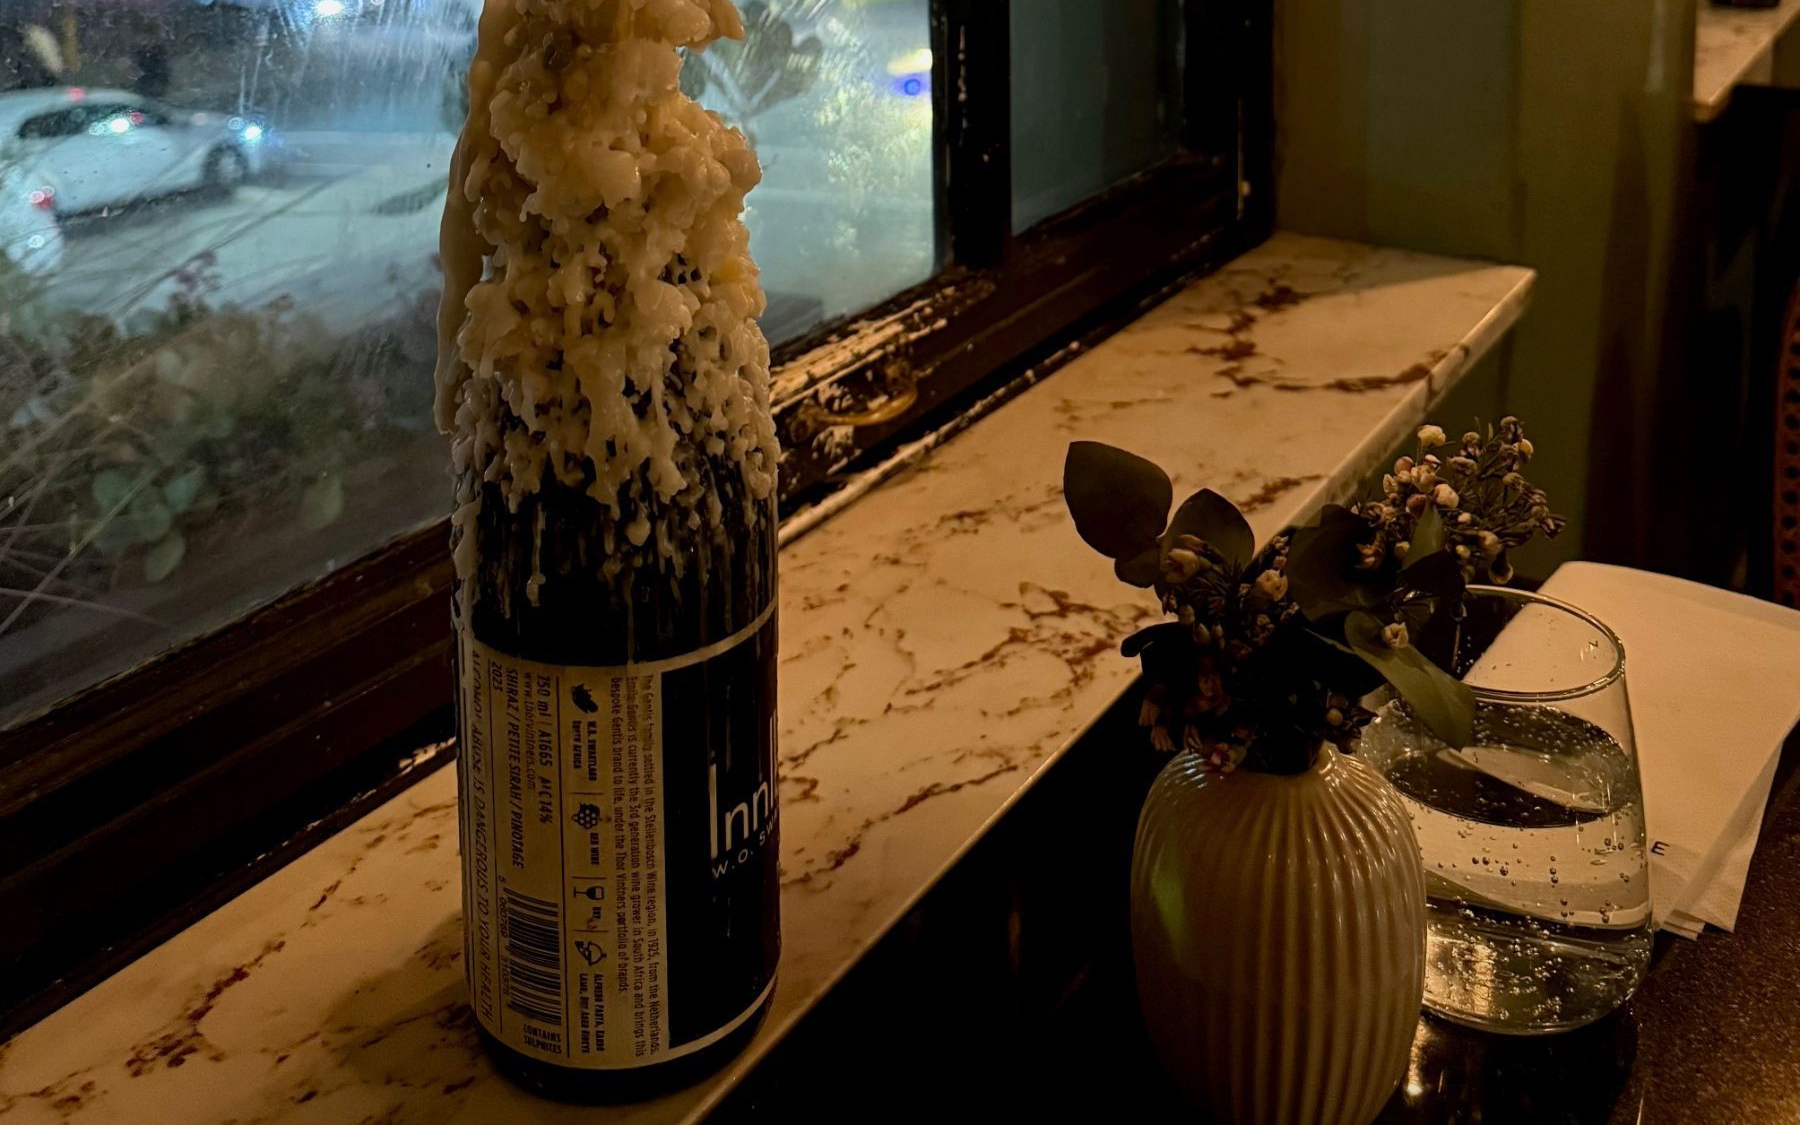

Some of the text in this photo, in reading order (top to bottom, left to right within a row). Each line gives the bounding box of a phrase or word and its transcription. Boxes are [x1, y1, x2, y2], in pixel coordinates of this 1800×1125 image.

[492, 661, 503, 692] 2023
[537, 675, 550, 697] 750
[642, 675, 654, 690] The
[506, 667, 520, 713] SHIRAZ
[610, 677, 622, 714] bespoke
[538, 701, 552, 716] ml
[627, 705, 639, 732] Gentis
[642, 693, 654, 721] Gentis
[508, 722, 521, 763] PETITE
[612, 717, 624, 745] Gentis
[642, 723, 654, 751] family
[472, 725, 483, 773] ABUSE
[539, 730, 552, 766] A1665
[573, 745, 582, 769] AFRICA
[613, 748, 624, 773] brand
[627, 745, 640, 784] currently
[644, 755, 655, 784] settled
[474, 777, 485, 795] IS
[509, 763, 522, 800] SIRAH
[613, 775, 624, 785] to
[644, 787, 656, 795] in
[630, 787, 640, 801] the
[645, 797, 656, 812] the
[539, 801, 553, 823] 14%
[614, 807, 626, 831] under
[630, 804, 641, 819] 3rd
[474, 795, 489, 893] DANGEROUS
[510, 811, 524, 869] PINOTAGE
[590, 833, 600, 865] RED WINE
[615, 835, 626, 849] the
[628, 821, 641, 868] generation
[645, 815, 656, 868] Stellenbosch
[616, 851, 627, 870] Thor
[712, 848, 754, 879] W.O.
[616, 874, 628, 909] Vintners
[631, 873, 642, 892] wine
[646, 871, 658, 893] Wine
[478, 895, 490, 915] TO
[630, 895, 642, 924] grower
[645, 896, 658, 926] region,
[480, 921, 490, 960] YOUR
[617, 913, 630, 949] portfolio
[632, 927, 643, 936] in
[648, 928, 658, 936] in
[618, 952, 630, 960] of
[632, 939, 644, 963] South
[647, 939, 660, 961] 1925,
[618, 963, 630, 994] brands.
[634, 966, 645, 991] Africa
[648, 963, 660, 982] from
[480, 964, 494, 1022] HEALTH
[634, 993, 645, 1009] and
[649, 985, 660, 999] the
[523, 1025, 562, 1043] CONTAINS
[634, 1011, 646, 1039] brings
[523, 1035, 562, 1054] SULPHITES
[635, 1041, 647, 1057] this
